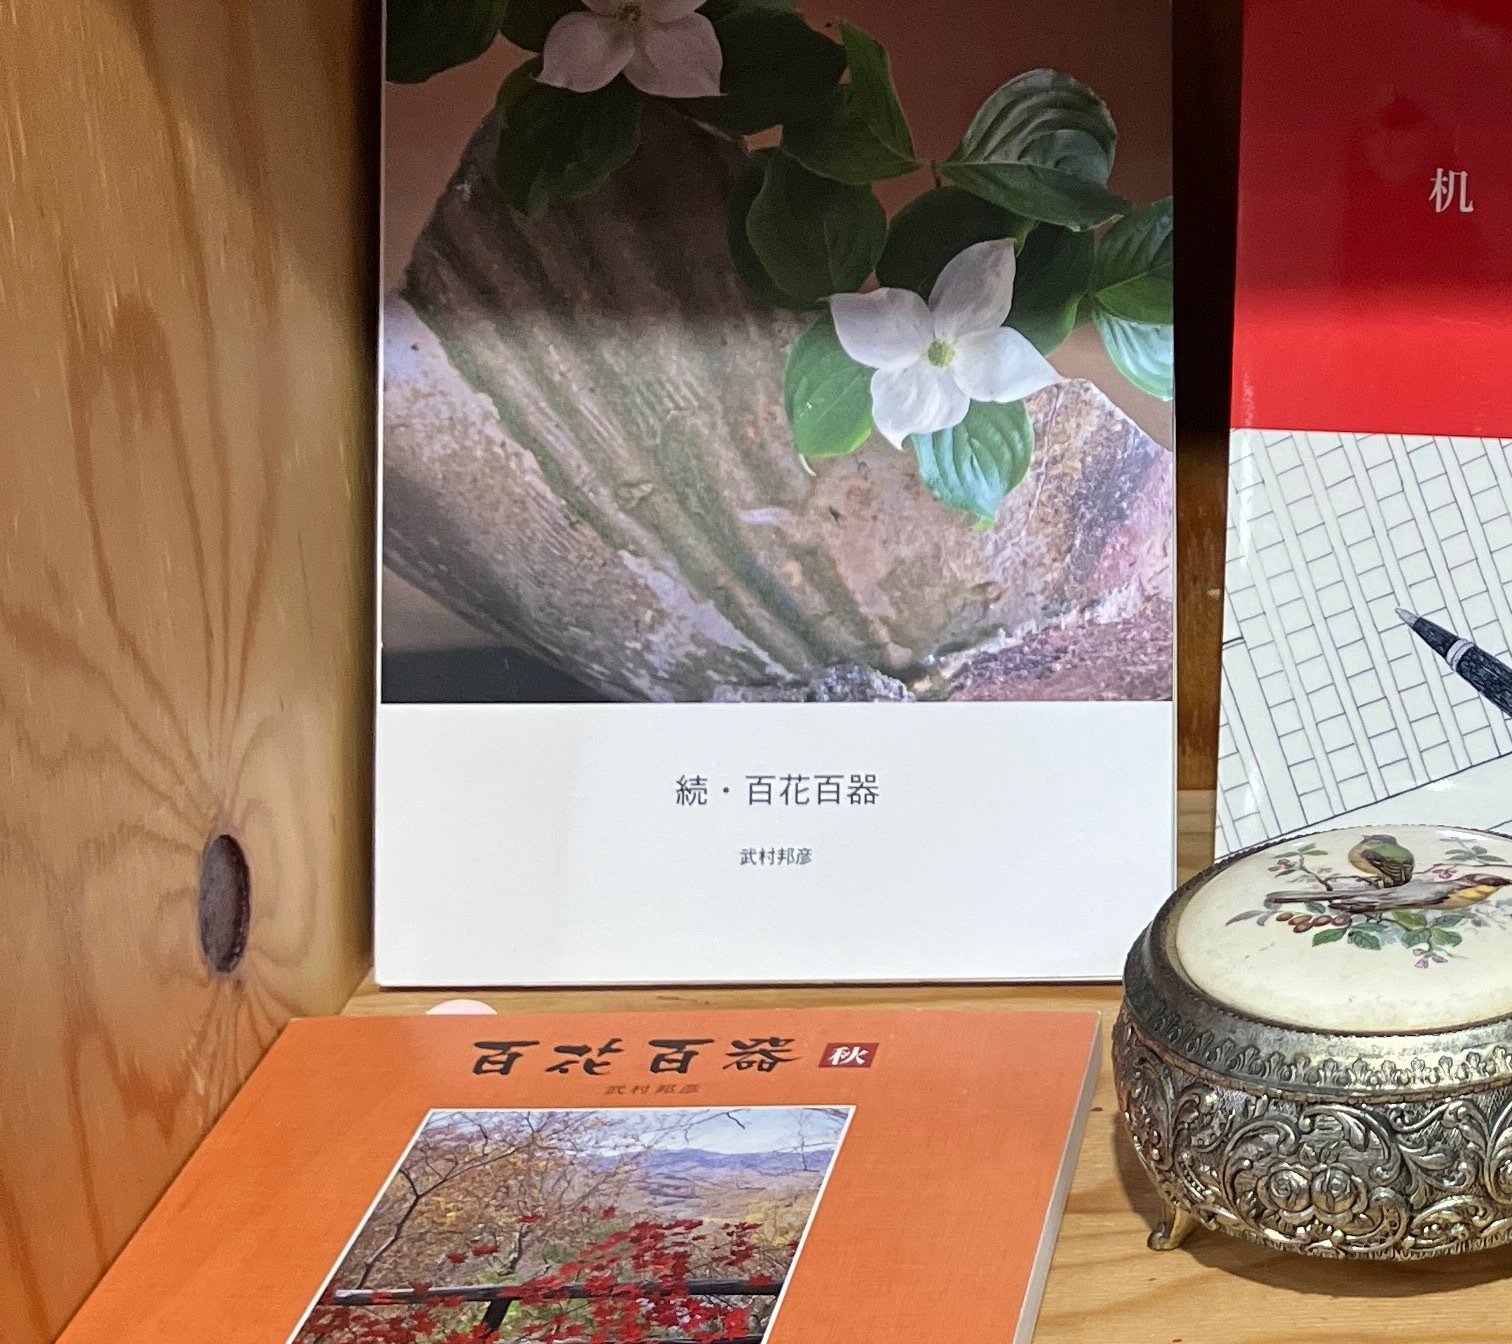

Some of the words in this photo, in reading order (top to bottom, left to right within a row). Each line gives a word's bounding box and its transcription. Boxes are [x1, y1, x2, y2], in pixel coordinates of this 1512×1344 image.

[675, 774, 880, 806] 続・百花百器
[739, 847, 812, 866] 武村邦彦
[472, 1037, 801, 1076] 百花百器
